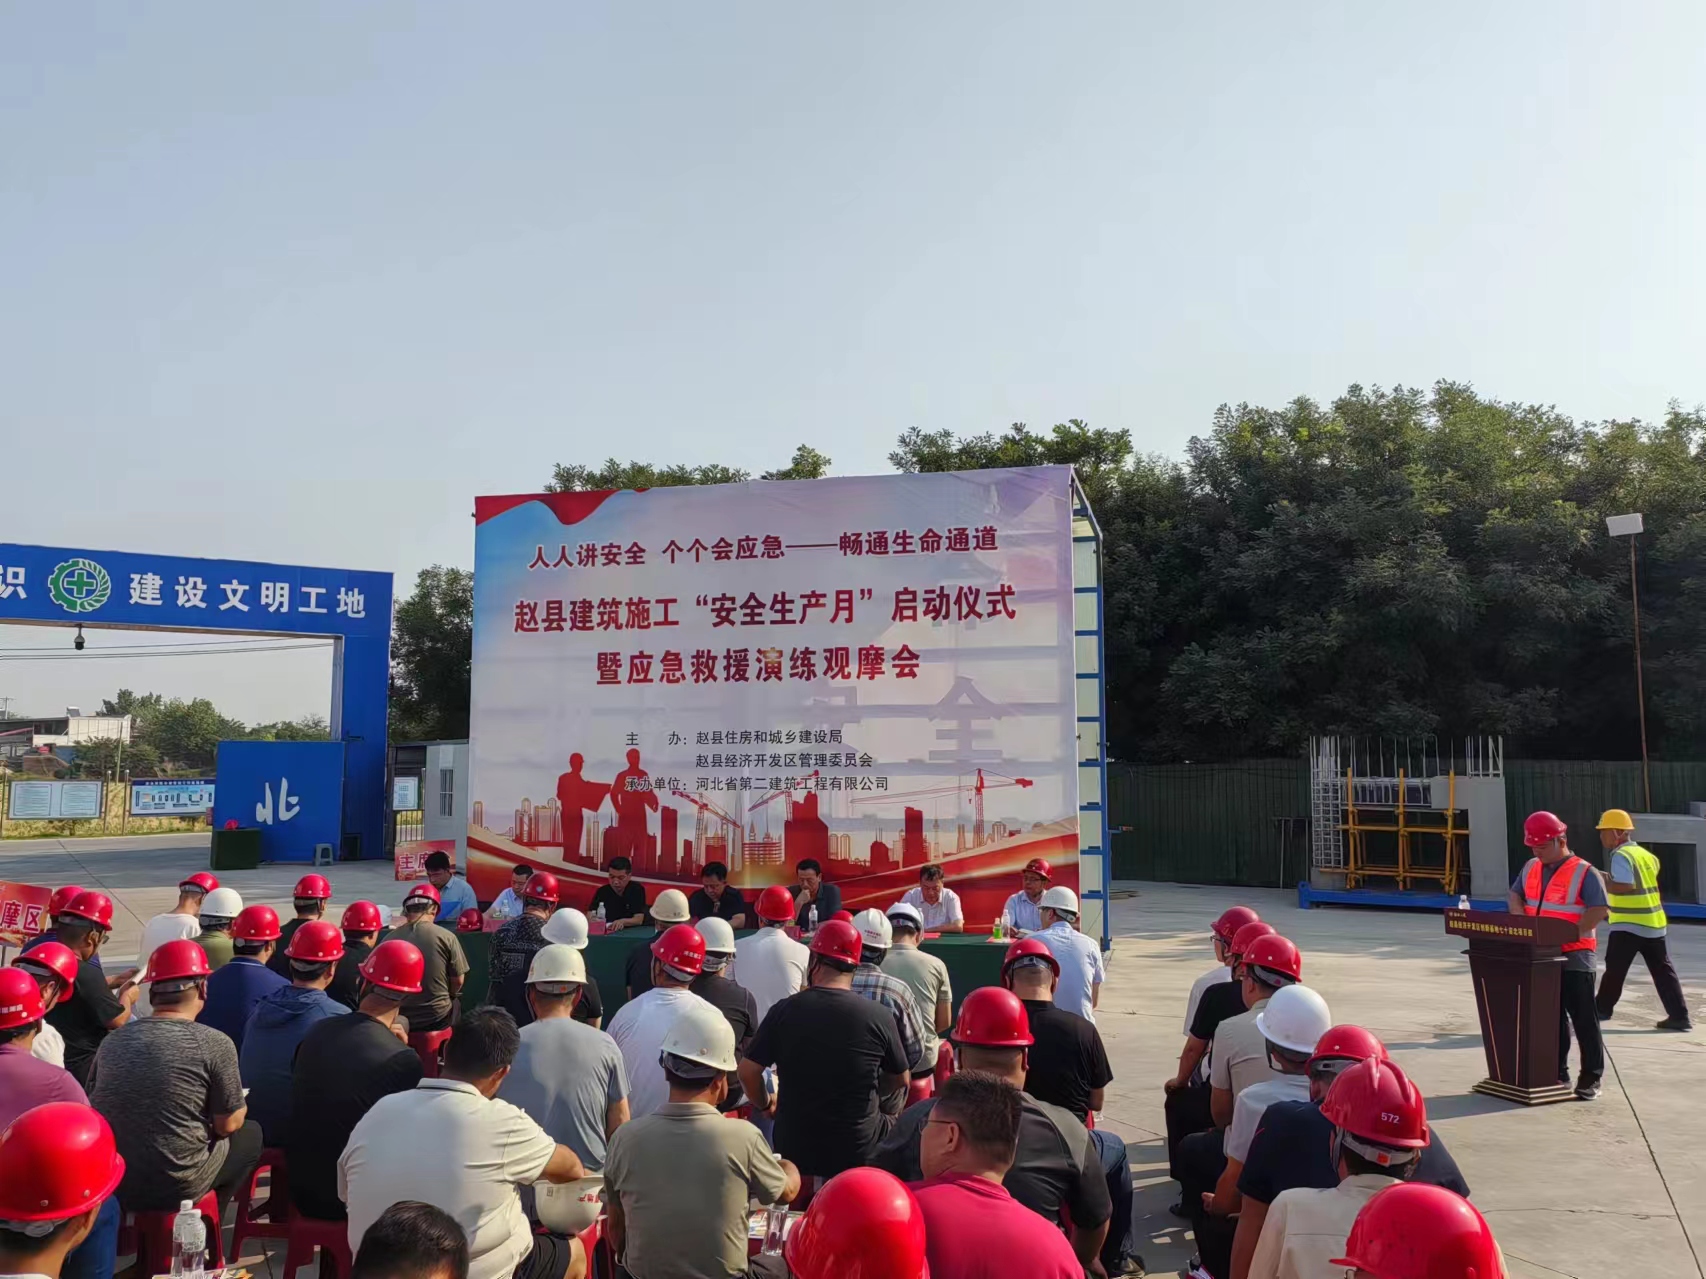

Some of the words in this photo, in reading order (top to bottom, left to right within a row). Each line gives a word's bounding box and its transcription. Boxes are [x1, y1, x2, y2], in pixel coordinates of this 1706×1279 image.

[529, 541, 647, 569] 人人讲安全
[129, 572, 366, 618] 建设文明工地
[596, 643, 921, 685] 暨应急救援演练观摩会
[695, 752, 874, 768] 赵县经济开发区管理委员会
[256, 776, 300, 825] 北
[1381, 1112, 1400, 1124] 572
